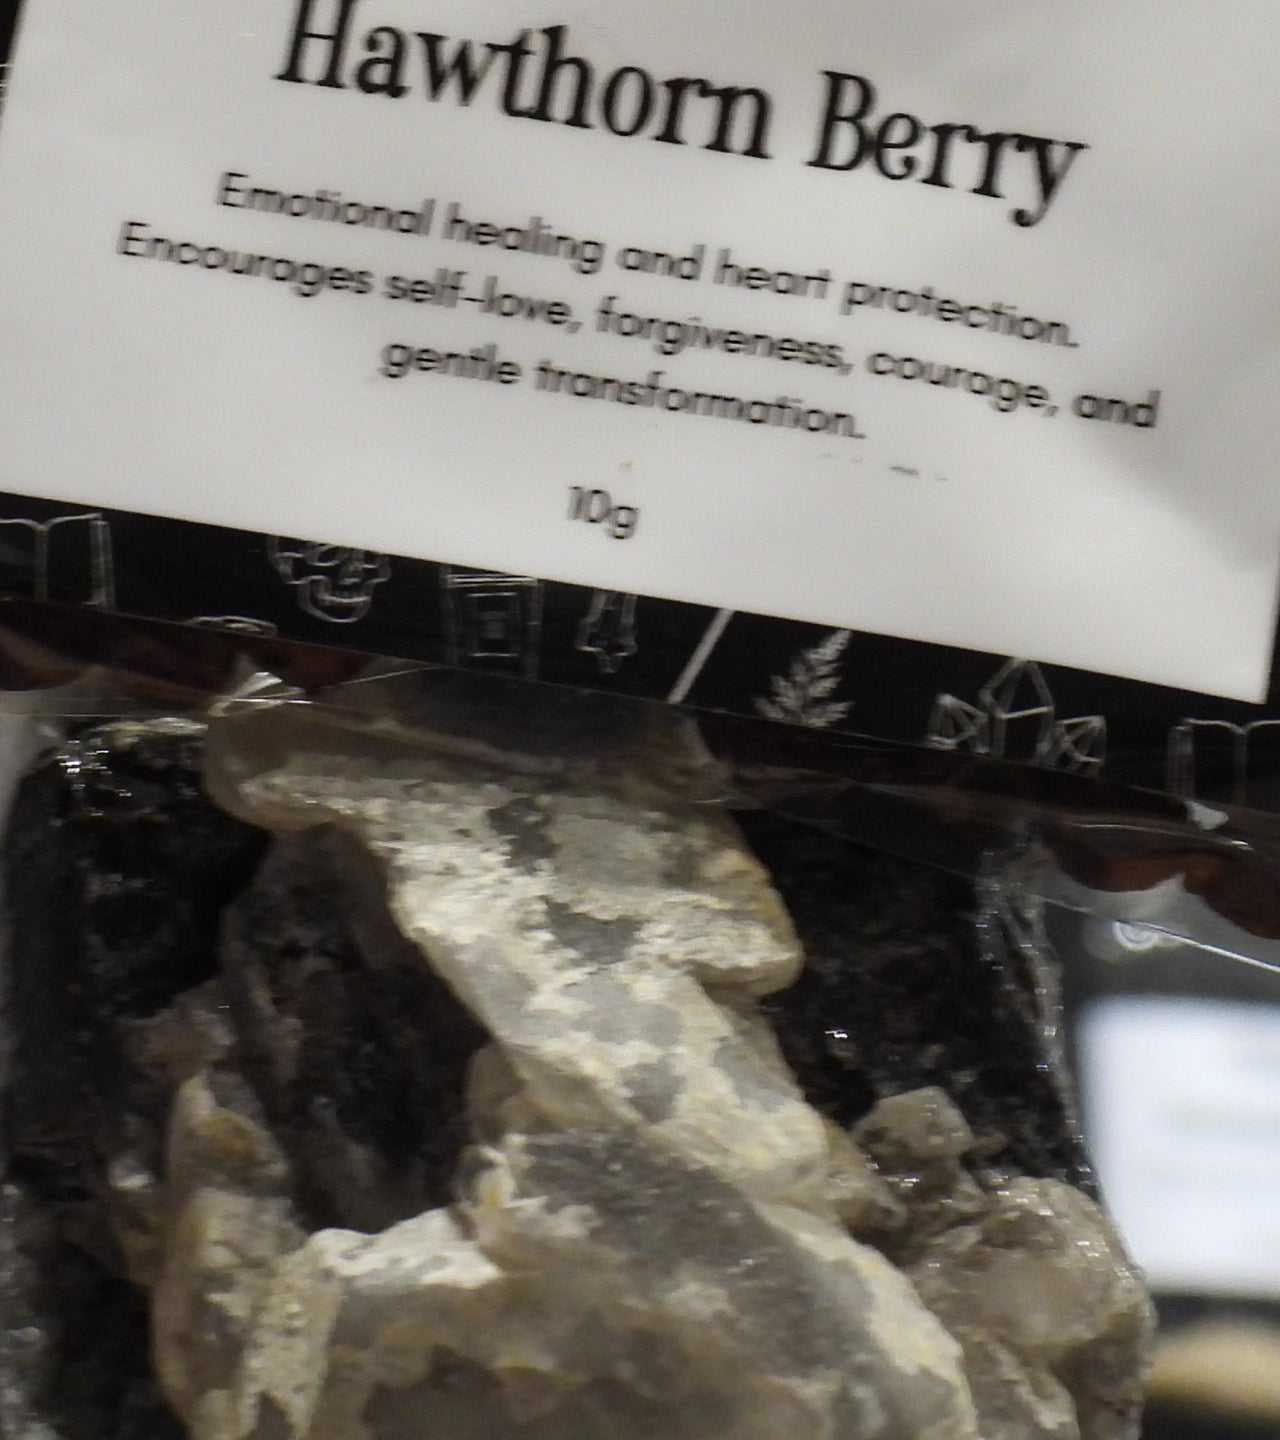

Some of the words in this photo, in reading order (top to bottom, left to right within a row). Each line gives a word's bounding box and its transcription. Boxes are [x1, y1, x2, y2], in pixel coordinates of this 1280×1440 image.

[806, 68, 1091, 228] Berry
[117, 220, 374, 297] Encourages
[382, 266, 584, 334] self-love,
[596, 295, 854, 377] forgiveness,
[864, 350, 1060, 418] courage,
[1070, 389, 1162, 430] and
[216, 171, 437, 237] Emotional
[441, 201, 606, 275] healing
[618, 244, 705, 282] and
[713, 247, 833, 300] heart
[838, 278, 1080, 349] protection.
[378, 342, 522, 385] gentle
[533, 359, 867, 440] transformation.
[567, 483, 639, 540] 10g
